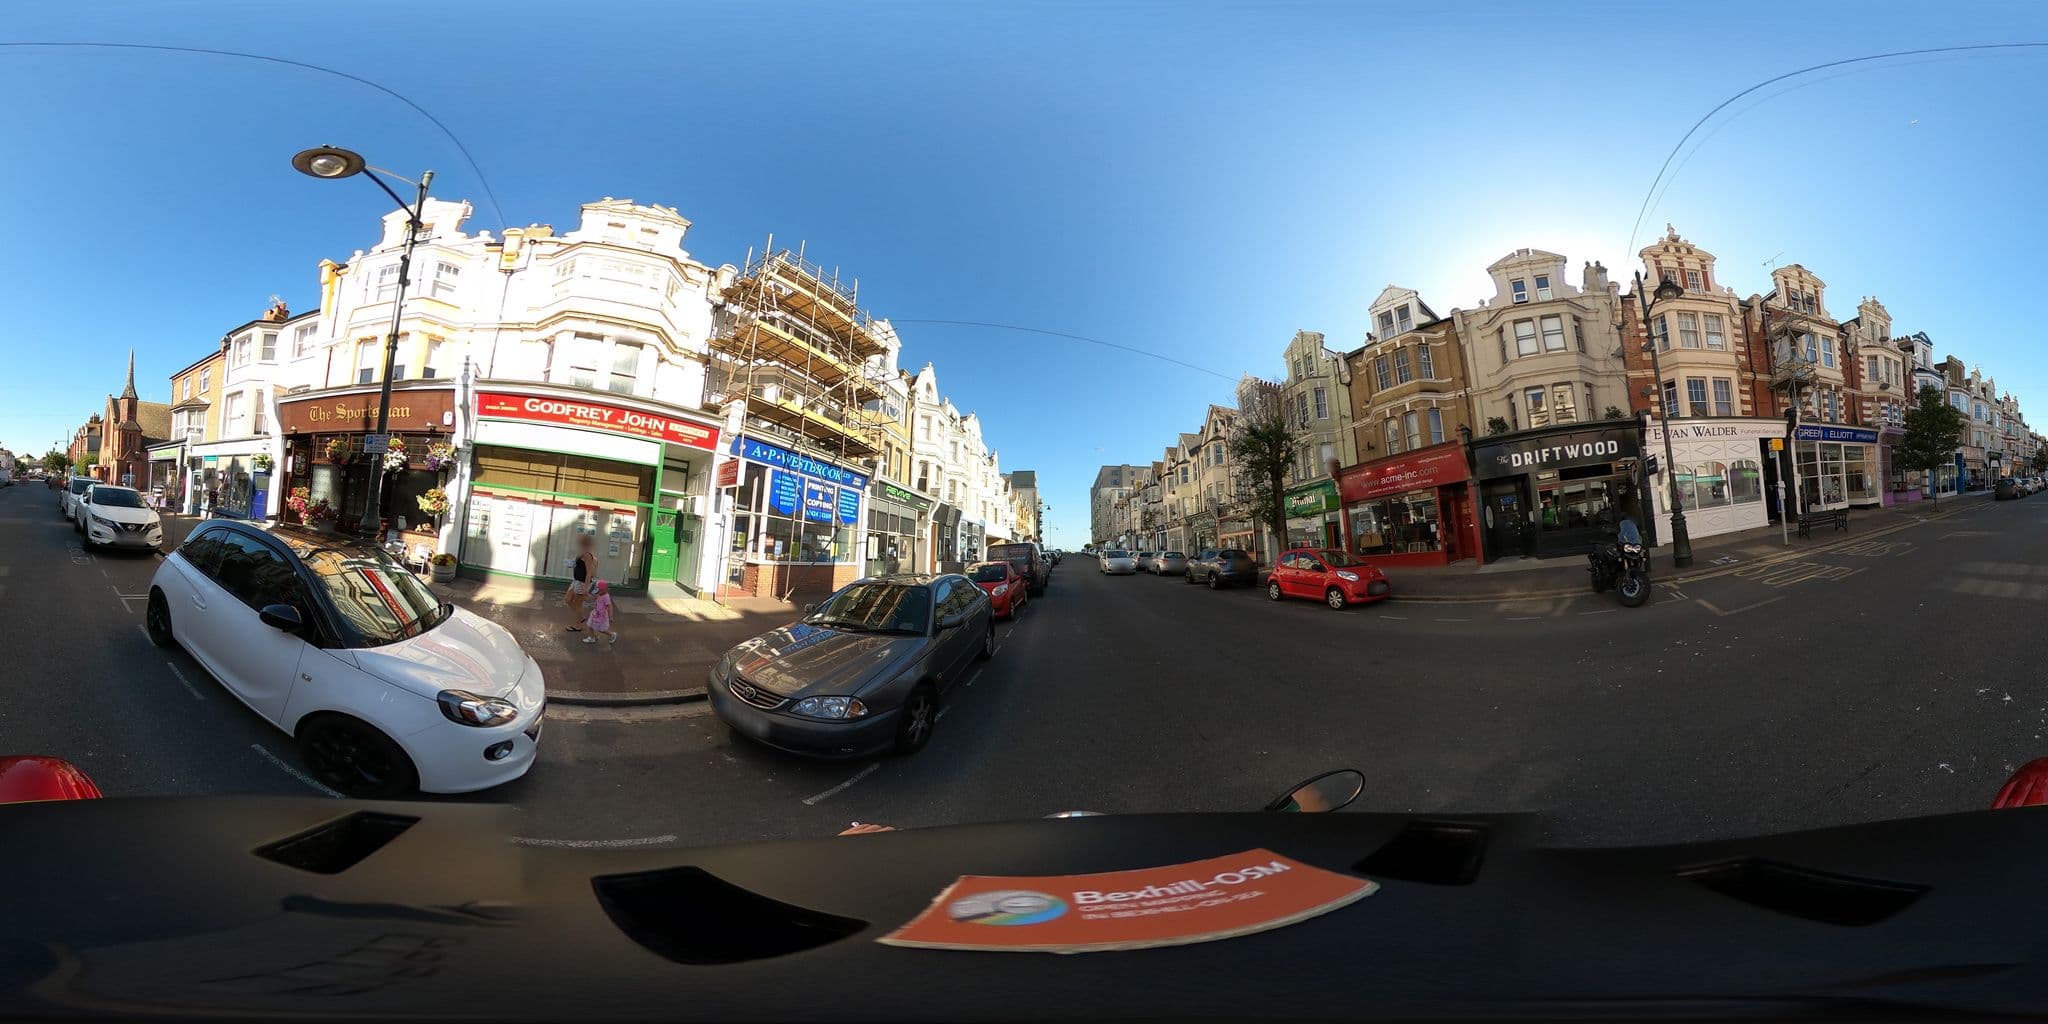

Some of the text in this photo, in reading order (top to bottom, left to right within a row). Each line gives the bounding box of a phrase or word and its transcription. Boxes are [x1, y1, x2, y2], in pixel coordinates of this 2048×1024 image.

[309, 403, 410, 422] The Sportsan
[524, 398, 612, 421] GODFREY
[617, 411, 666, 432] JOHN
[569, 417, 591, 426] Property
[592, 420, 624, 430] Management
[628, 426, 648, 434] Lettings
[1692, 426, 1737, 438] WALDER
[1799, 429, 1822, 438] GREEN
[1830, 430, 1853, 439] ELLIOTT
[1496, 440, 1618, 467] The DRIFTWOOD
[1360, 467, 1438, 488] www.acme-inc.com
[886, 486, 912, 500] REVIVE
[1072, 860, 1292, 904] Bexhill-OSM
[1078, 890, 1228, 912] OPEN MAPPING
[1110, 890, 1266, 918] BEXHILL-ON-SEA
